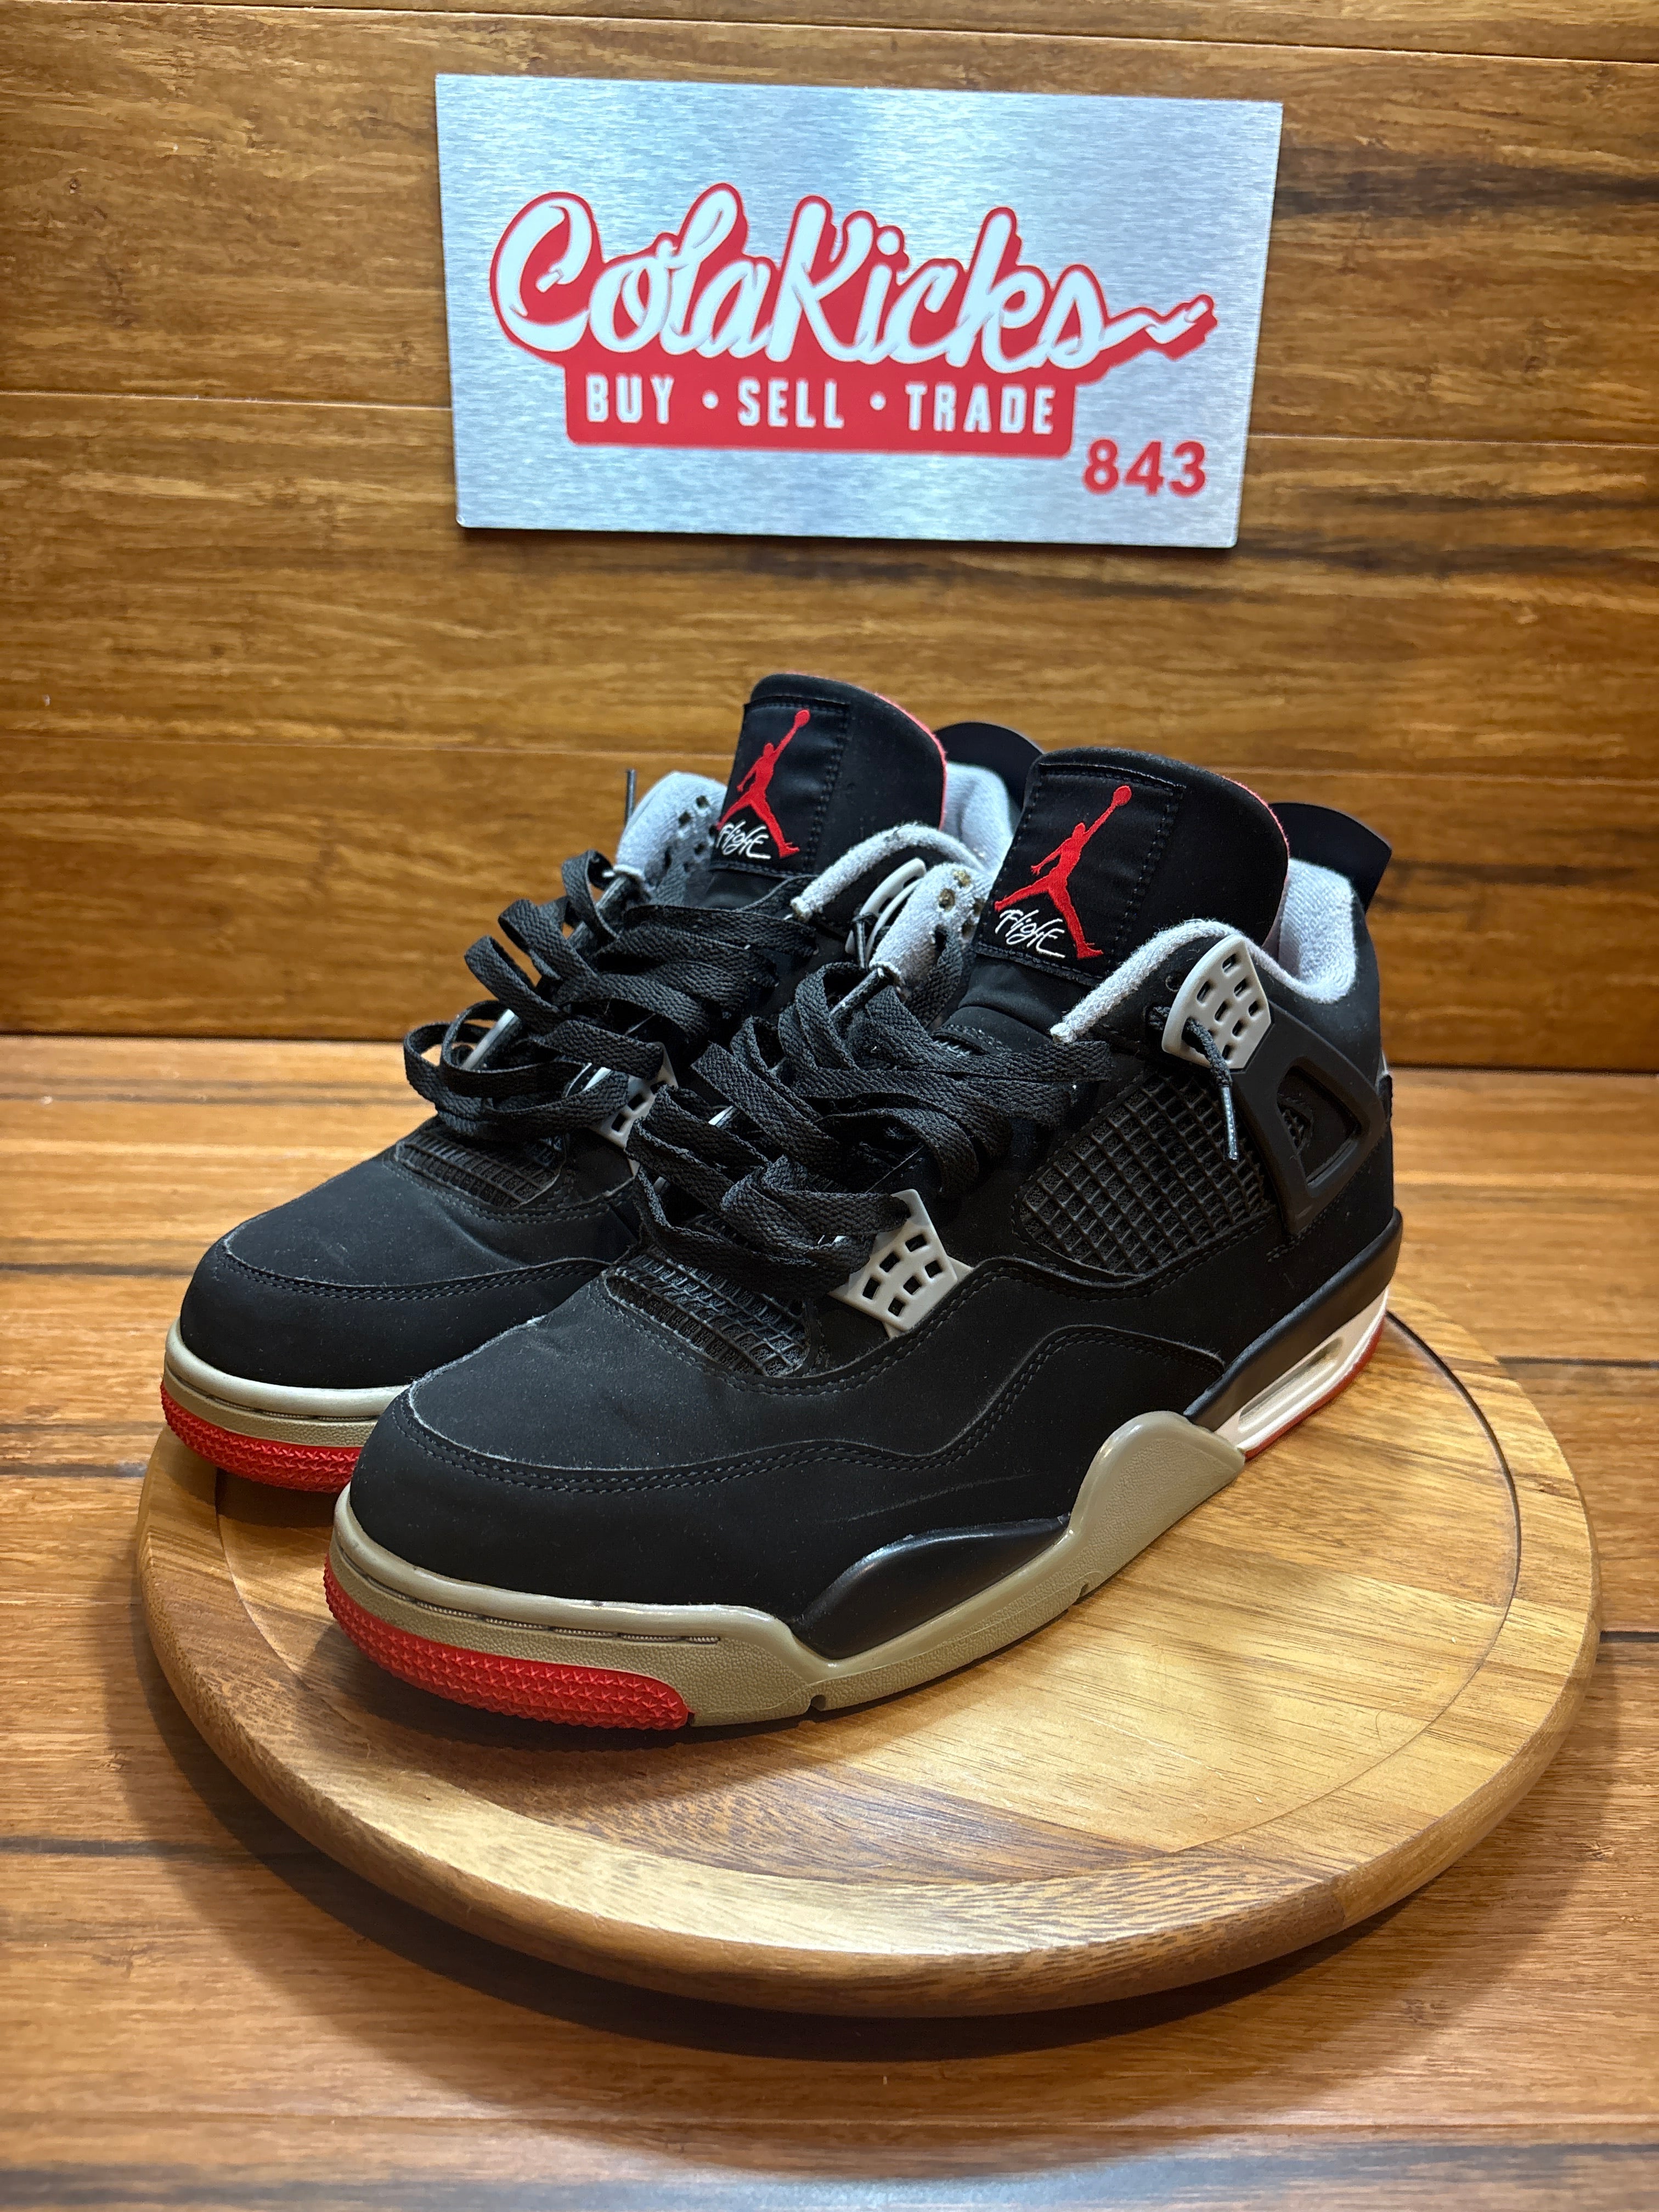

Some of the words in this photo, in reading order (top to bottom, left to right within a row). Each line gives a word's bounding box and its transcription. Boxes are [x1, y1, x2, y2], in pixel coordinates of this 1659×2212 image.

[586, 374, 674, 424] BUY
[737, 378, 844, 429] SELL
[905, 383, 1054, 434] TRADE
[1084, 440, 1206, 495] 843
